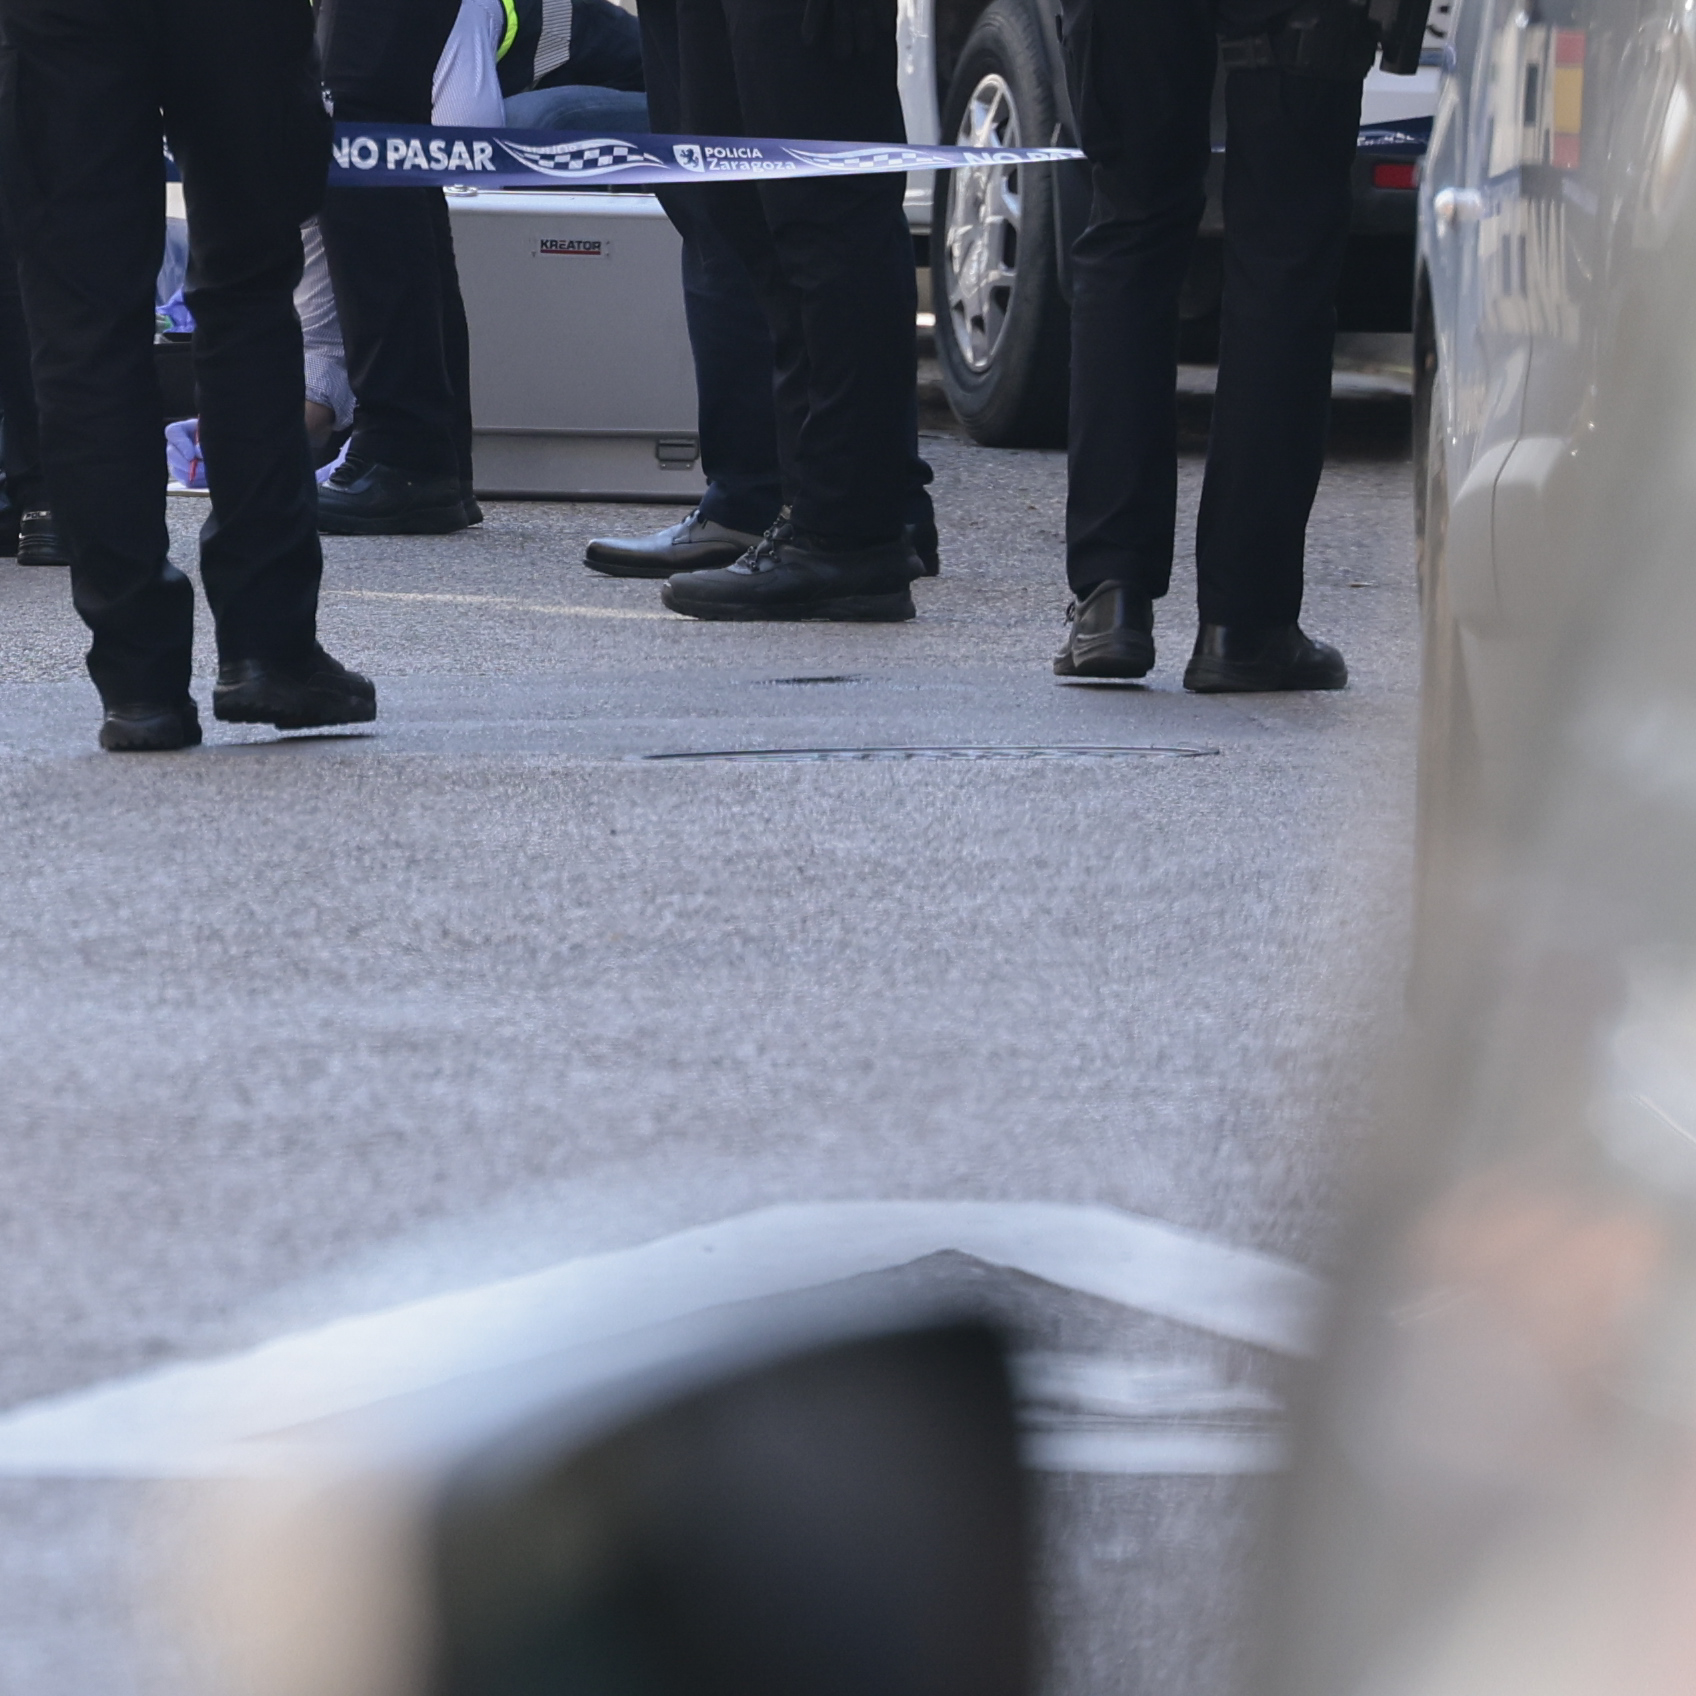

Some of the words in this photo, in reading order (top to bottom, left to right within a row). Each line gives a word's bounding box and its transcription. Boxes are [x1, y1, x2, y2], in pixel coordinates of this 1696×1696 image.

[386, 137, 497, 171] PASAR
[704, 147, 763, 159] POLICIA
[706, 158, 796, 173] Zaragoza
[540, 239, 602, 251] KREATOR
